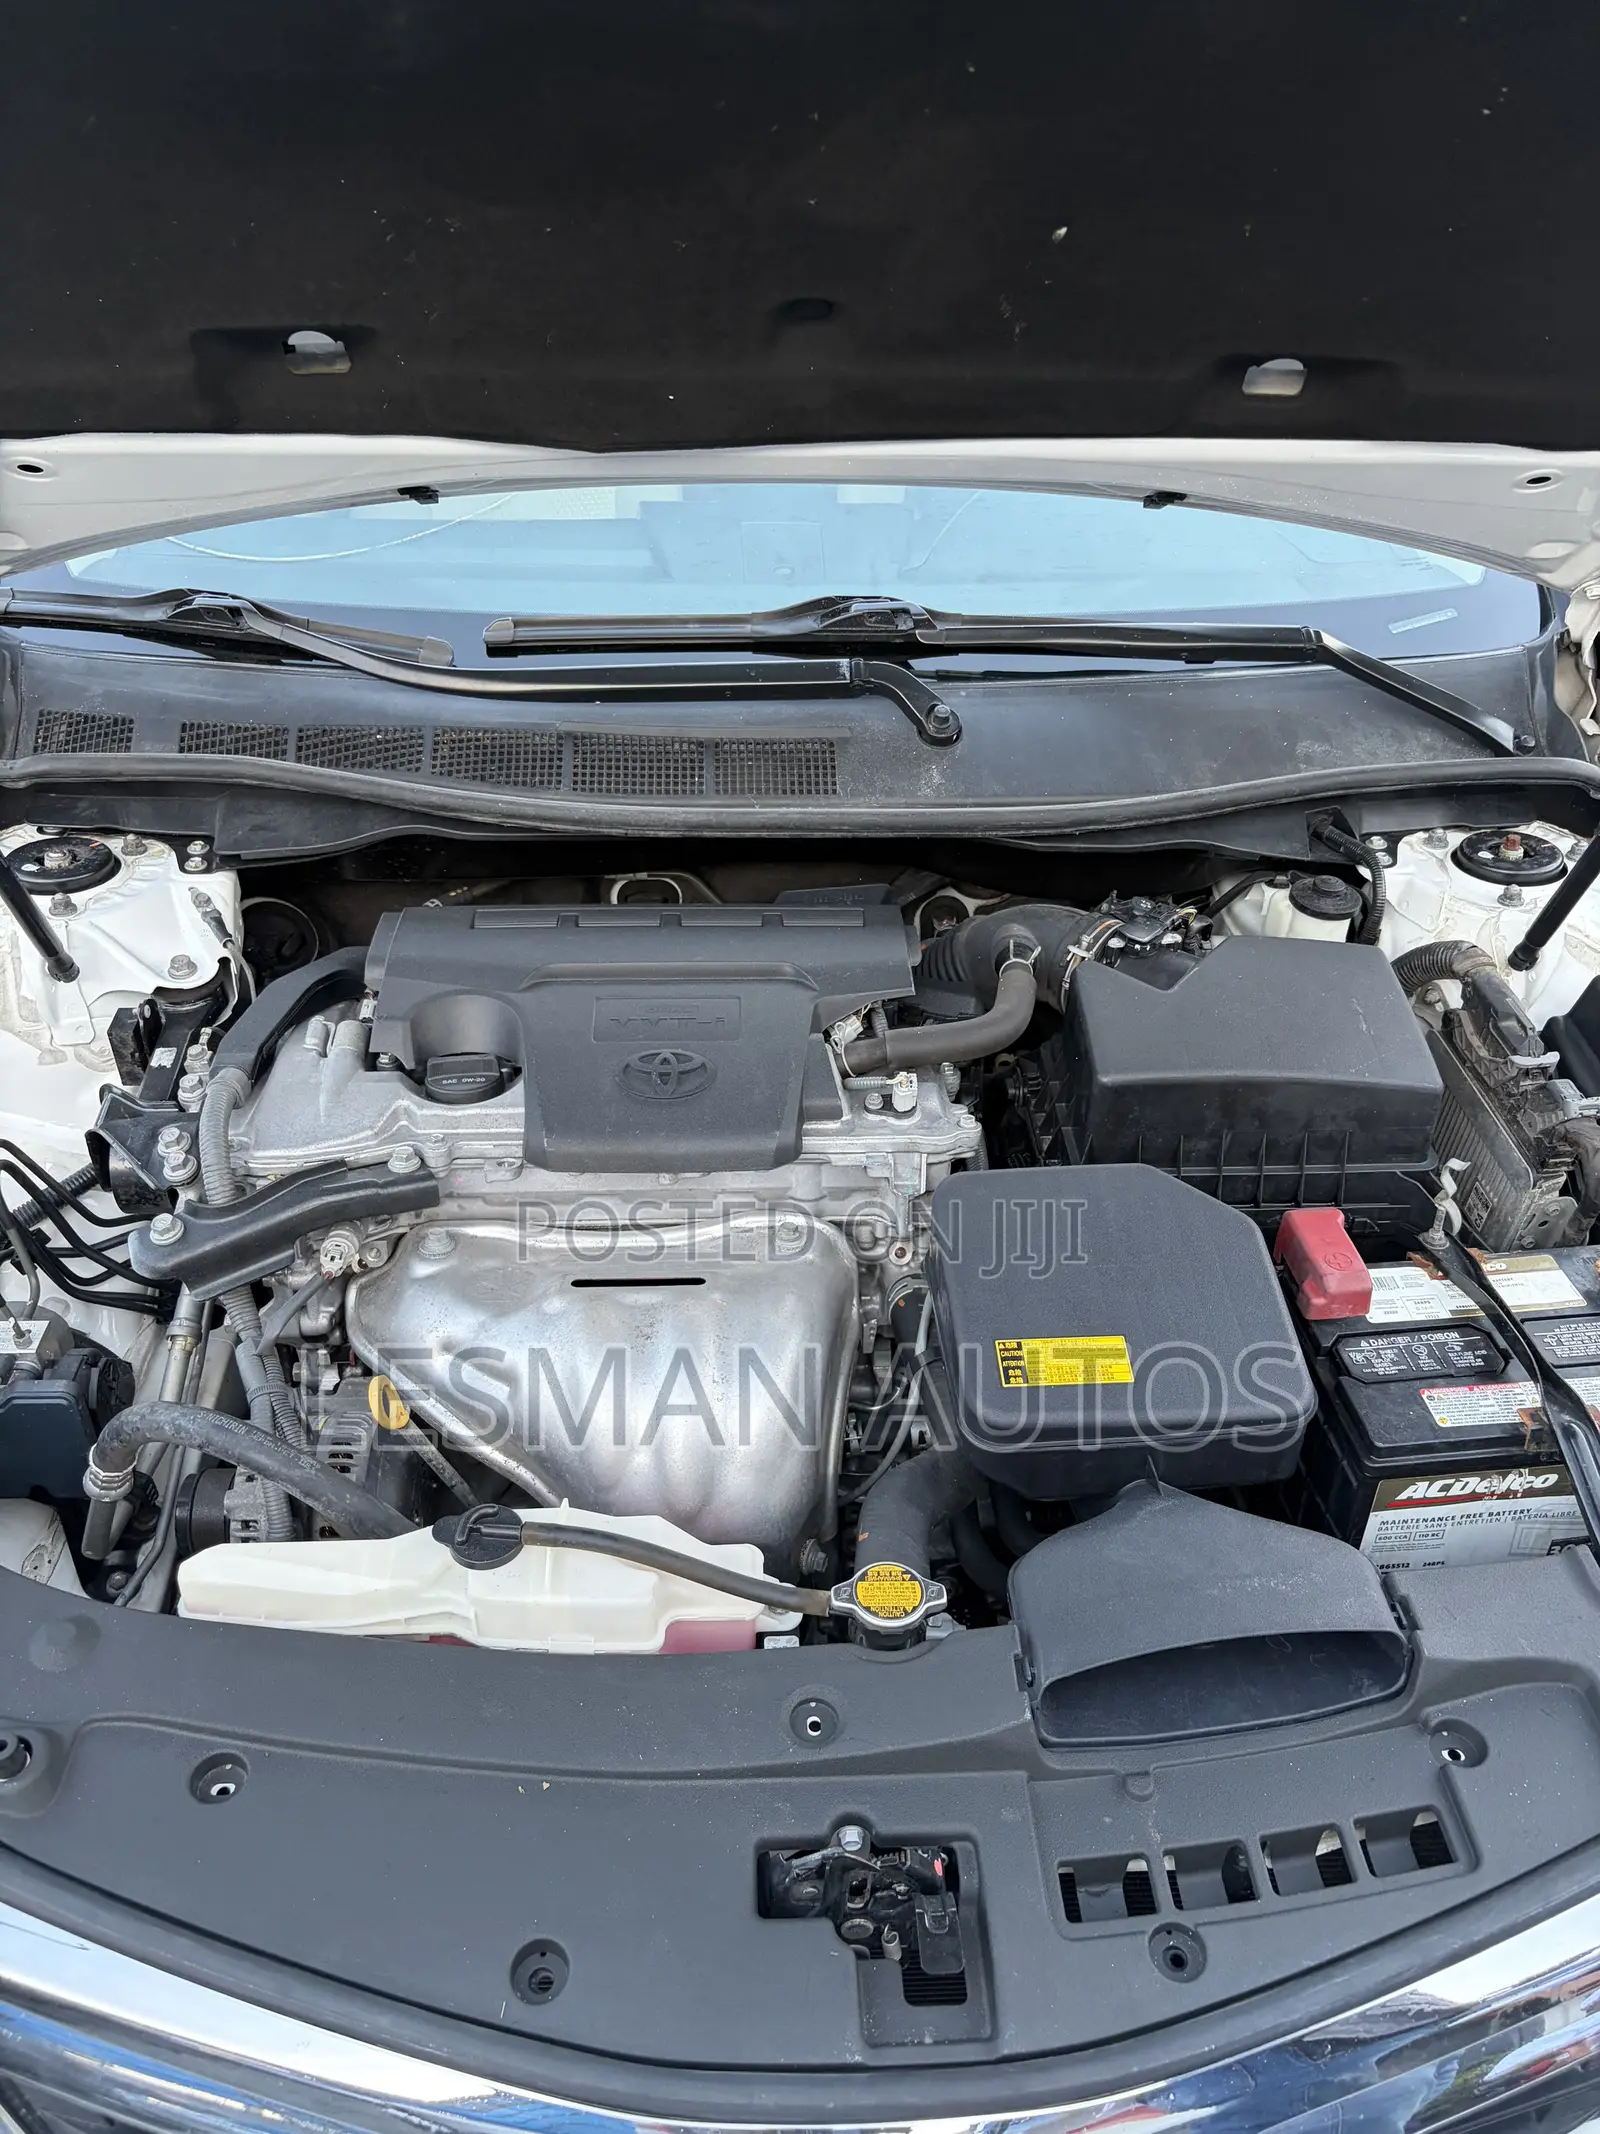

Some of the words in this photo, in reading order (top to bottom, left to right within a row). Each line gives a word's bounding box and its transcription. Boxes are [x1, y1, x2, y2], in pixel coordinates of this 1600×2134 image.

[1369, 1336, 1412, 1347] DANGER
[1420, 1331, 1460, 1342] POISON
[1395, 1473, 1559, 1500] ACDelco
[1377, 1524, 1420, 1532] BATTERIE
[1450, 1516, 1501, 1527] ENTRETIEN
[1551, 1510, 1578, 1518] LIBRE
[1379, 1514, 1457, 1526] MAINTENANCE
[1460, 1511, 1484, 1520] FREE
[1487, 1507, 1533, 1518] BATTERY
